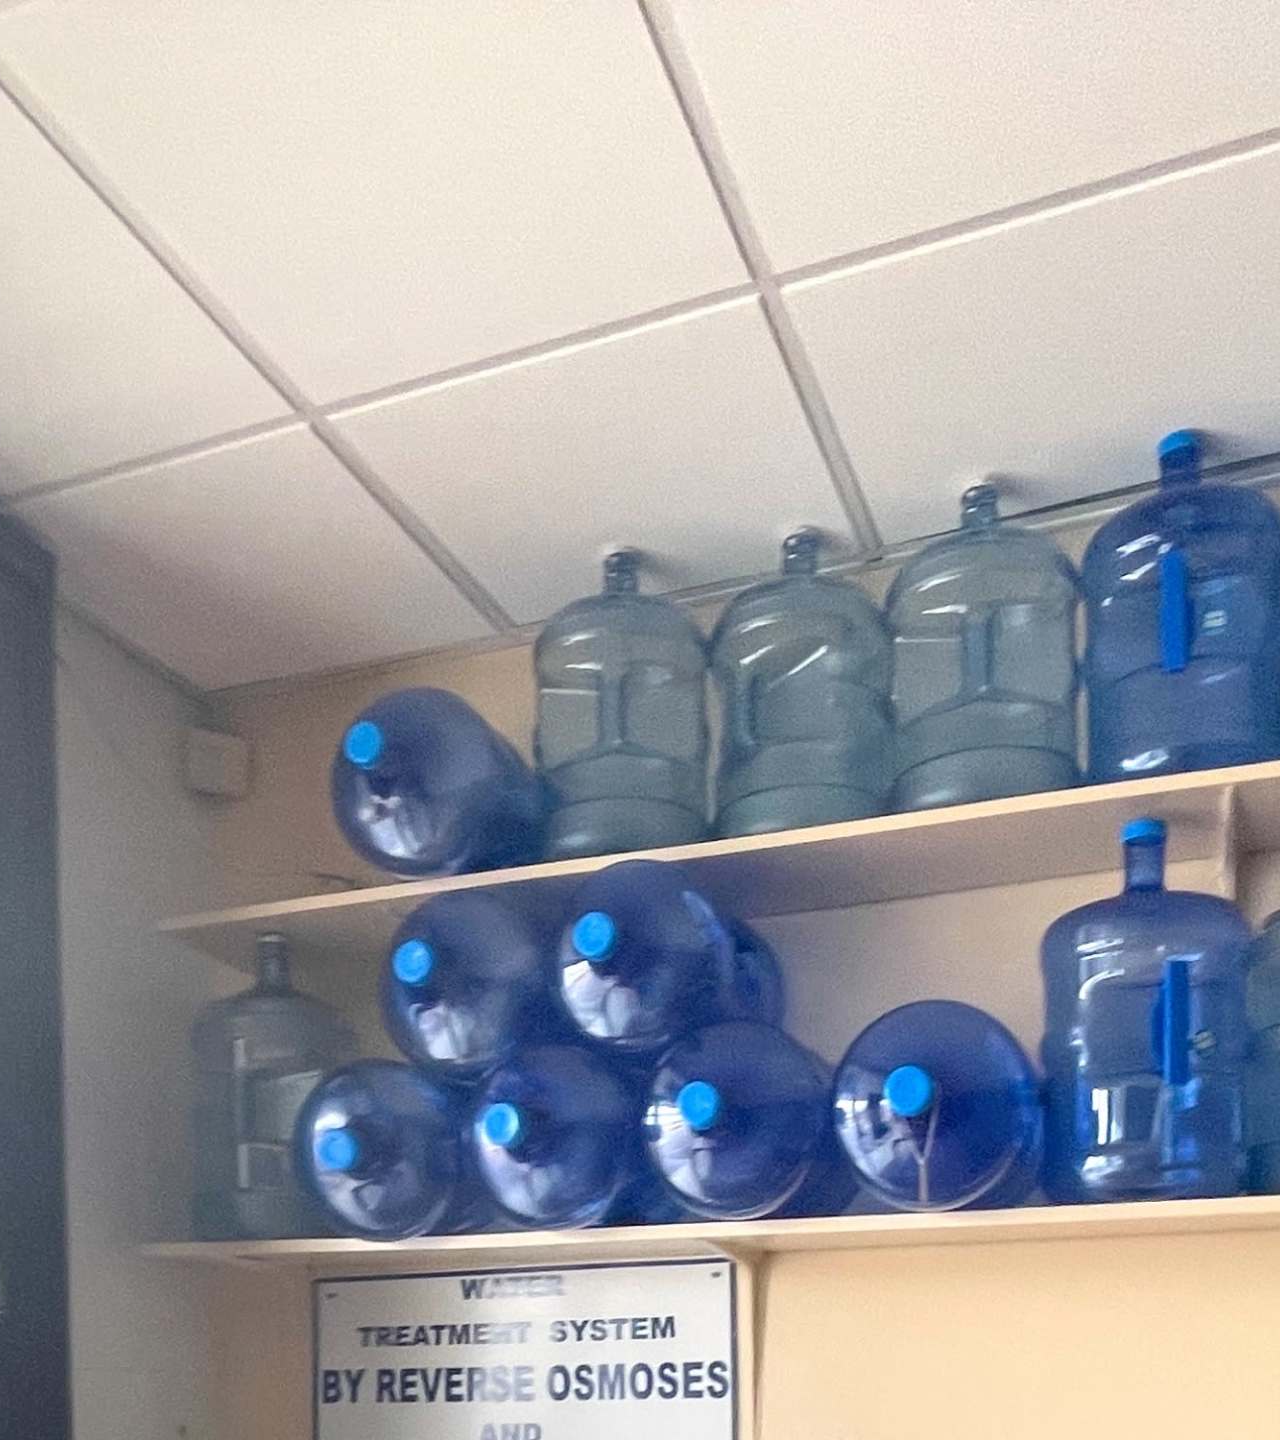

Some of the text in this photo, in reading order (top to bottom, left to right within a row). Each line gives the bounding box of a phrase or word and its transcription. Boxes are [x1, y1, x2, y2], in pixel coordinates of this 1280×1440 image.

[461, 1276, 564, 1299] WATER
[358, 1315, 676, 1347] TREATMENT SYSTEM
[322, 1360, 730, 1404] BY REVERSE OSMOSES
